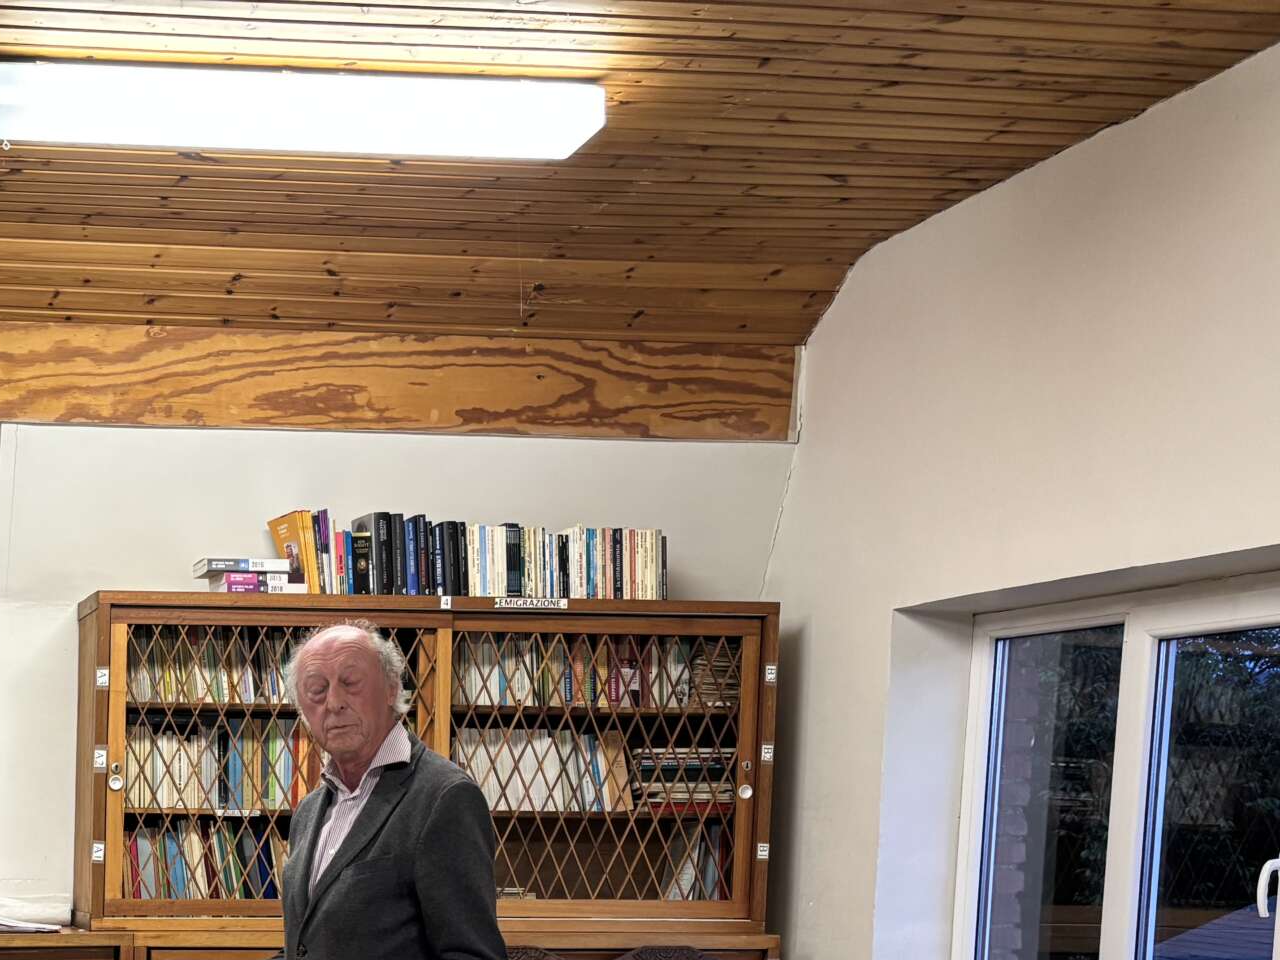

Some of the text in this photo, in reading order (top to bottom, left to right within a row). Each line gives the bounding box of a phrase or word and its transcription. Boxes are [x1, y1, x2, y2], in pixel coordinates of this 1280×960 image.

[497, 598, 562, 608] EMIGRAZIONE
[767, 667, 776, 681] B3
[95, 752, 105, 767] A2
[763, 747, 773, 760] B2
[94, 845, 103, 859] A1
